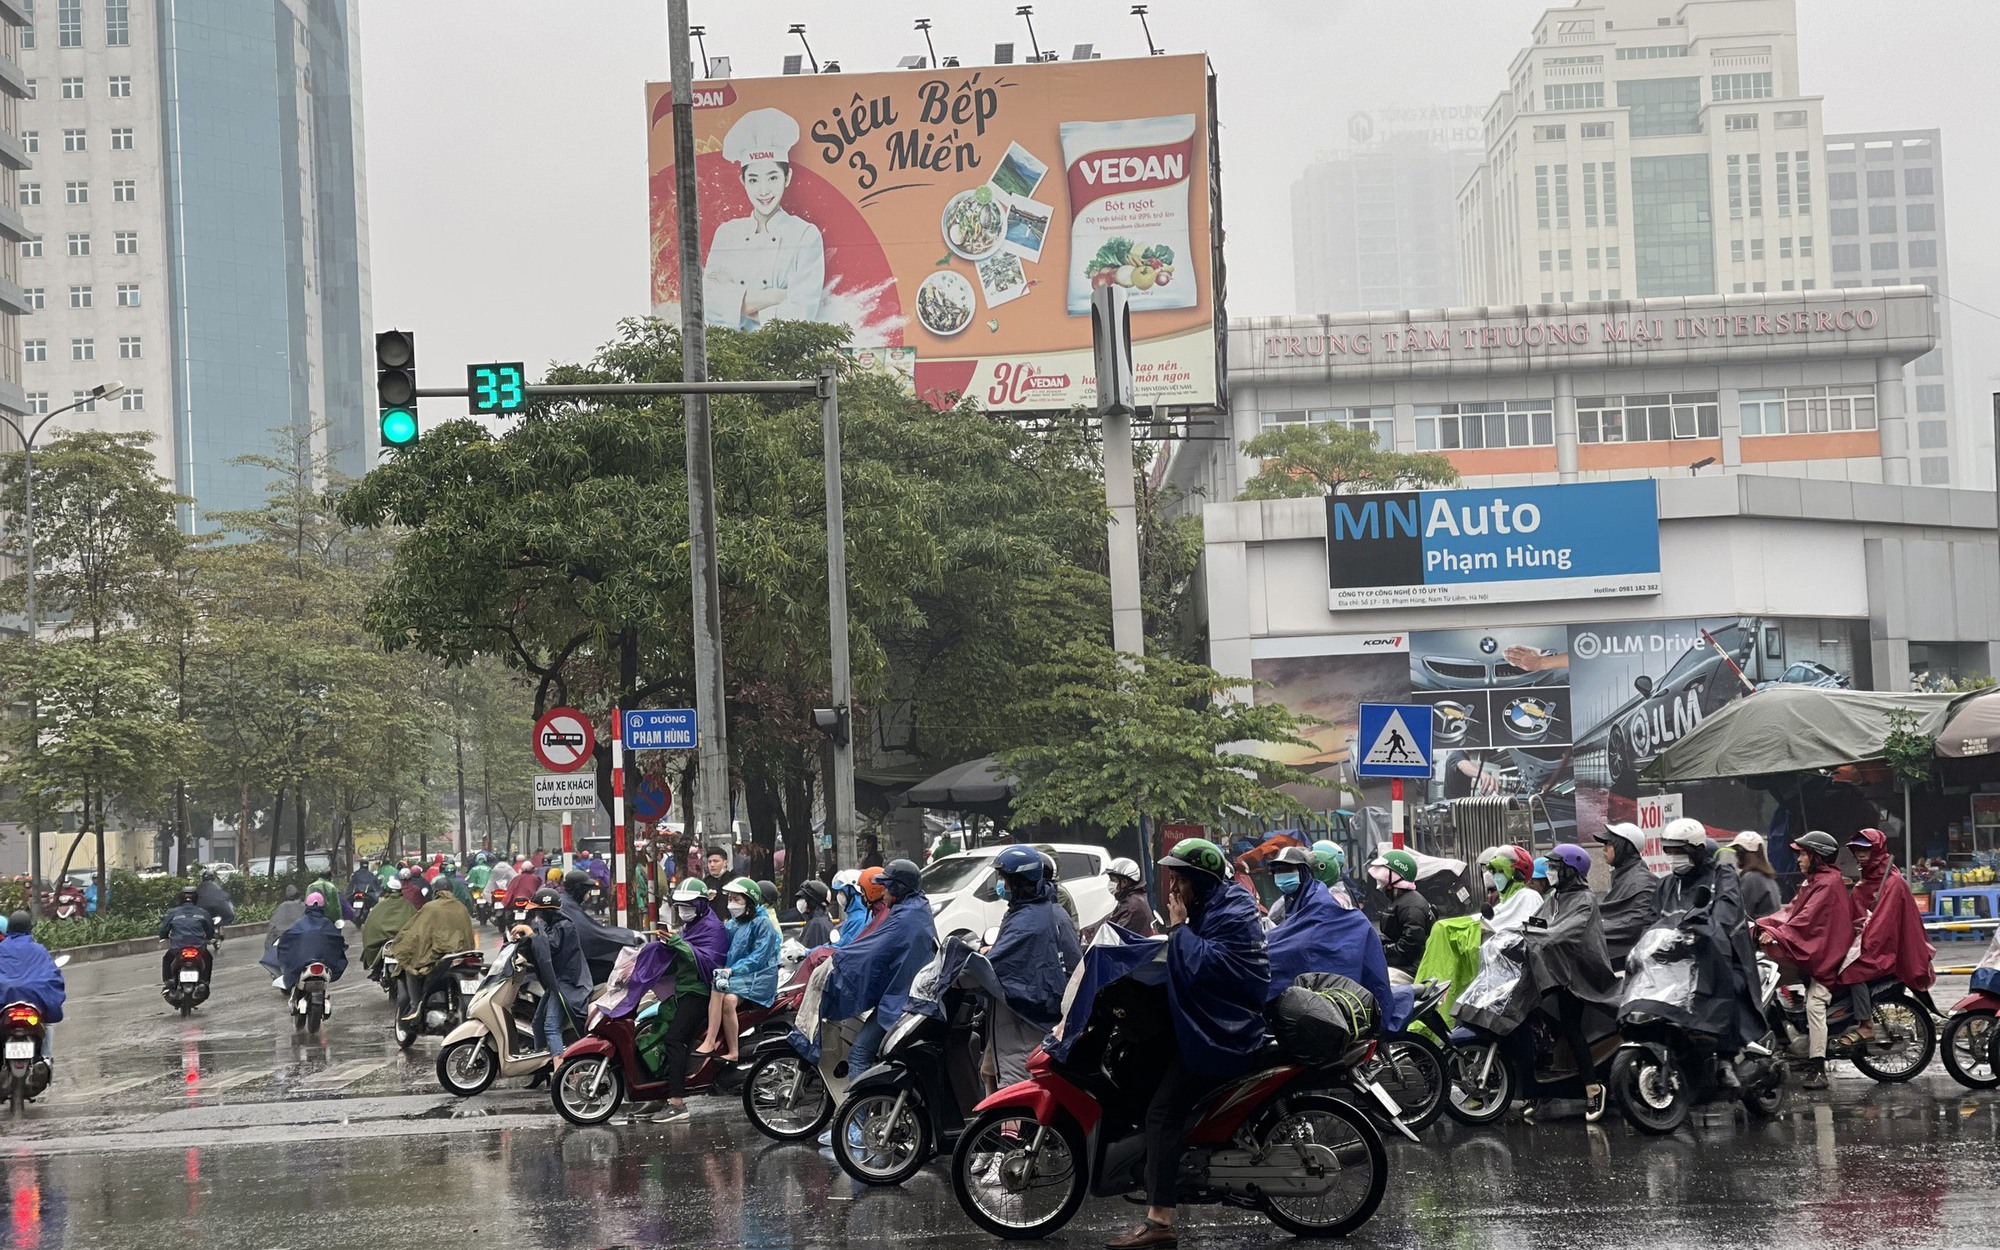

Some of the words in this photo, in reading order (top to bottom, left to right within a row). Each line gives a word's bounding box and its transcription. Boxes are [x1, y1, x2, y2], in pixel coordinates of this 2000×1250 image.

[692, 91, 724, 107] DAN
[811, 92, 899, 164] Siêu
[918, 72, 997, 136] Bếp
[749, 151, 774, 160] VEDAN
[849, 151, 877, 189] 3
[886, 129, 981, 172] Miền
[1079, 153, 1183, 185] VEDAN
[1105, 201, 1124, 212] Bột
[1128, 199, 1154, 212] ngọt
[1265, 333, 1371, 358] TRUNG
[1383, 323, 1450, 352] TÂM
[1461, 321, 1589, 350] THƯƠNG
[1602, 319, 1663, 346] MẠI
[1676, 306, 1879, 338] INTERSERCO
[1136, 362, 1153, 374] tạo
[1158, 360, 1177, 372] nên
[1030, 377, 1064, 388] VEDAN
[1135, 373, 1158, 382] món
[1163, 372, 1190, 383] ngon
[476, 367, 521, 408] 33
[1333, 499, 1417, 540] MN
[1425, 498, 1541, 537] Auto
[1427, 550, 1498, 574] Phạm
[1507, 544, 1571, 570] Hùng
[1338, 590, 1356, 598] CÔNG
[1375, 589, 1392, 597] CÔNG
[1394, 588, 1411, 596] NGHỆ
[1419, 587, 1427, 595] TÔ
[1363, 638, 1395, 646] KONI
[1602, 635, 1643, 654] JLM
[1650, 633, 1706, 651] Drive
[650, 713, 687, 724] ĐƯỜNG
[1651, 689, 1703, 745] JLM
[633, 731, 661, 746] PHẠM
[664, 728, 690, 743] HÙNG
[536, 777, 554, 791] CẤM
[556, 781, 566, 790] XE
[568, 778, 593, 790] KHÁCH
[537, 792, 562, 806] TUYẾN
[563, 792, 574, 805] CỐ
[576, 795, 593, 807] ĐỊNH
[1641, 802, 1661, 829] XÔI
[1164, 829, 1184, 840] Nhận
[1394, 859, 1409, 871] Grab
